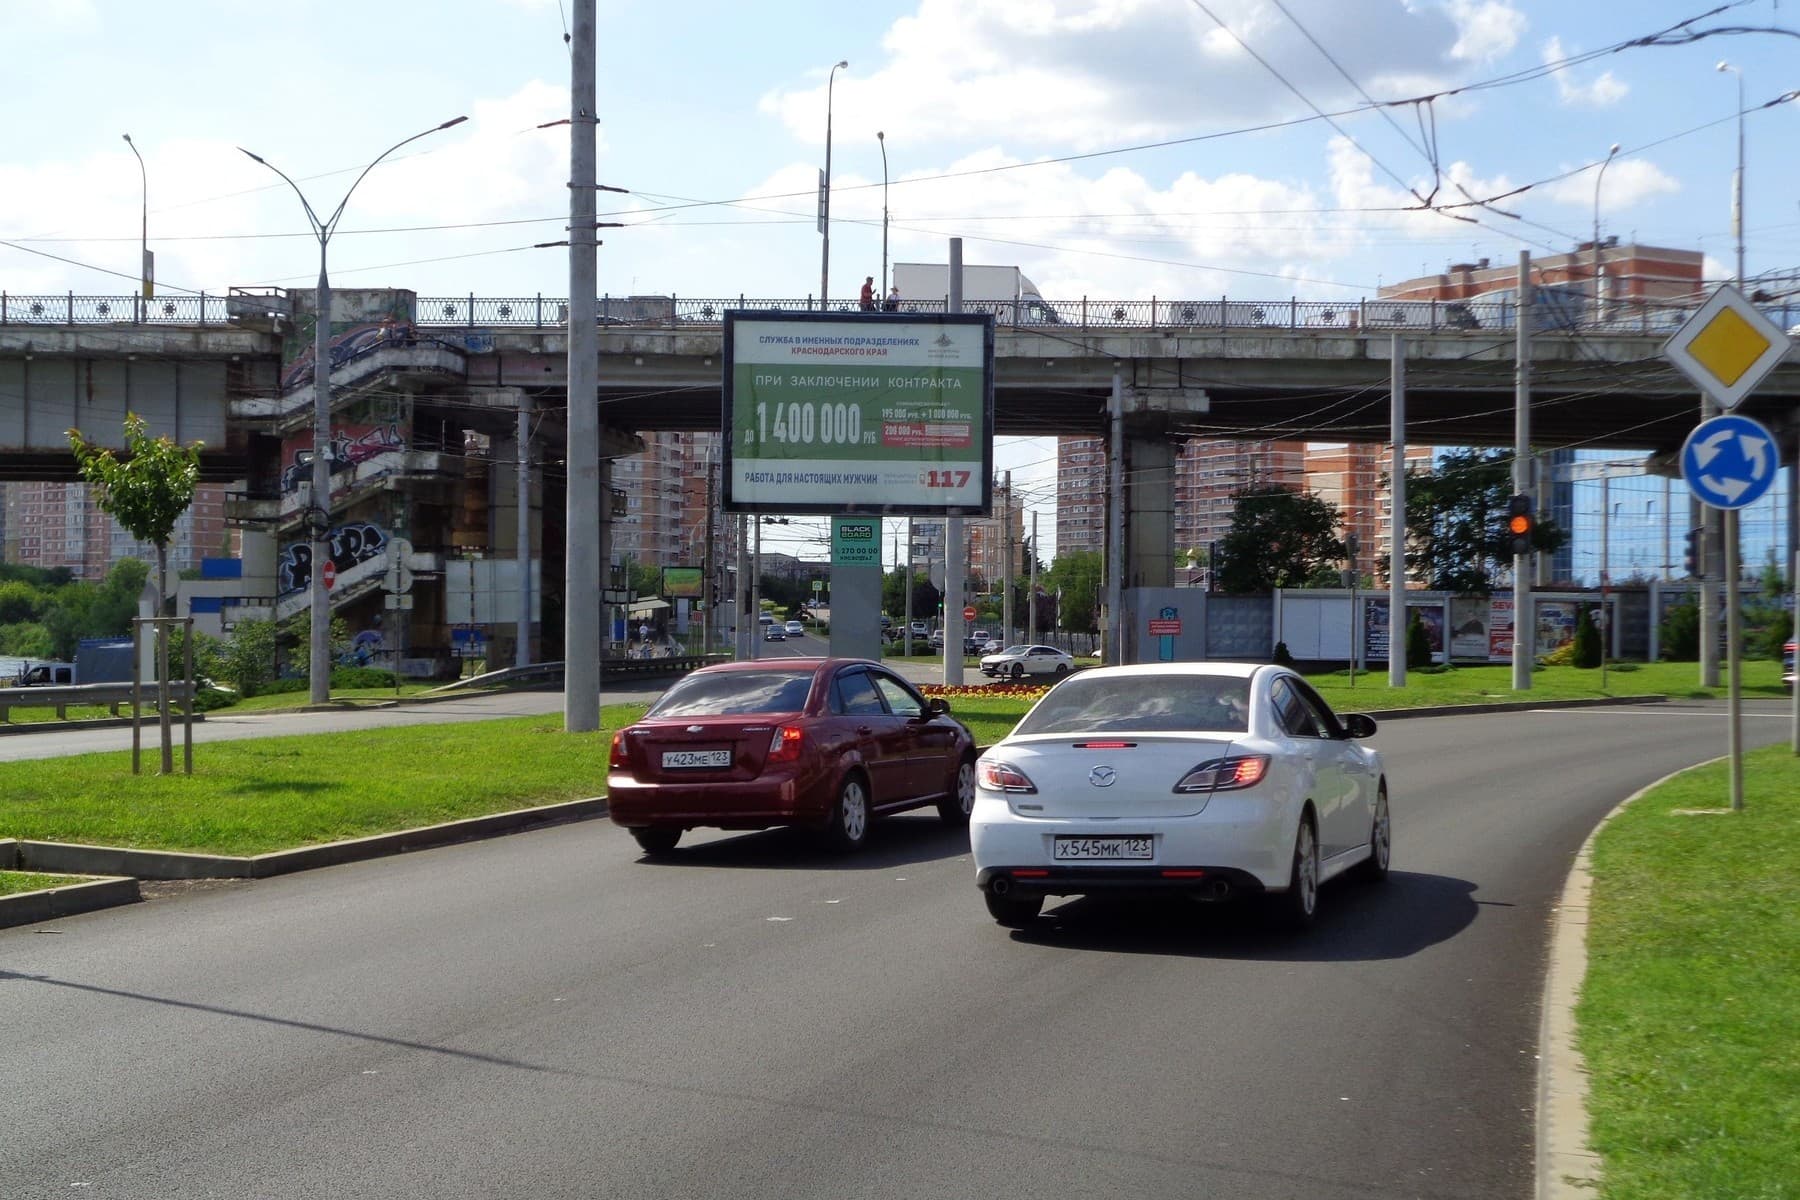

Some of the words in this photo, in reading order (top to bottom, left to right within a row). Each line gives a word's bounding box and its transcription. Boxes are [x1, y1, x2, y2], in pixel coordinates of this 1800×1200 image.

[759, 336, 794, 345] СЛУЖБА
[796, 336, 801, 344] В
[802, 336, 843, 345] ИМЕННЫХ
[844, 337, 920, 347] ПОДРАЗДЕЛЕНИЯХ
[791, 347, 865, 356] КРАСНОДАРСКОГО
[866, 348, 888, 356] КРАЯ
[755, 375, 782, 386] ПРИ
[790, 376, 880, 387] ЗАКЛЮЧЕНИИ
[888, 377, 962, 389] КОНТРАКТА
[894, 408, 907, 418] 000
[933, 409, 946, 419] 000
[946, 409, 960, 419] 000
[744, 429, 754, 445] ДО
[757, 401, 767, 443] 1
[773, 402, 814, 444] 400
[821, 402, 860, 444] 000
[744, 472, 775, 483] РАБОТА
[775, 473, 793, 485] ДЛЯ
[793, 473, 842, 485] НАСТОЯЩИХ
[843, 474, 878, 484] МУЖЧИН
[927, 471, 971, 488] 117
[666, 754, 708, 766] У423МЕ
[711, 752, 728, 762] 123
[1060, 840, 1121, 856] Х545МК
[1124, 840, 1148, 852] 123
